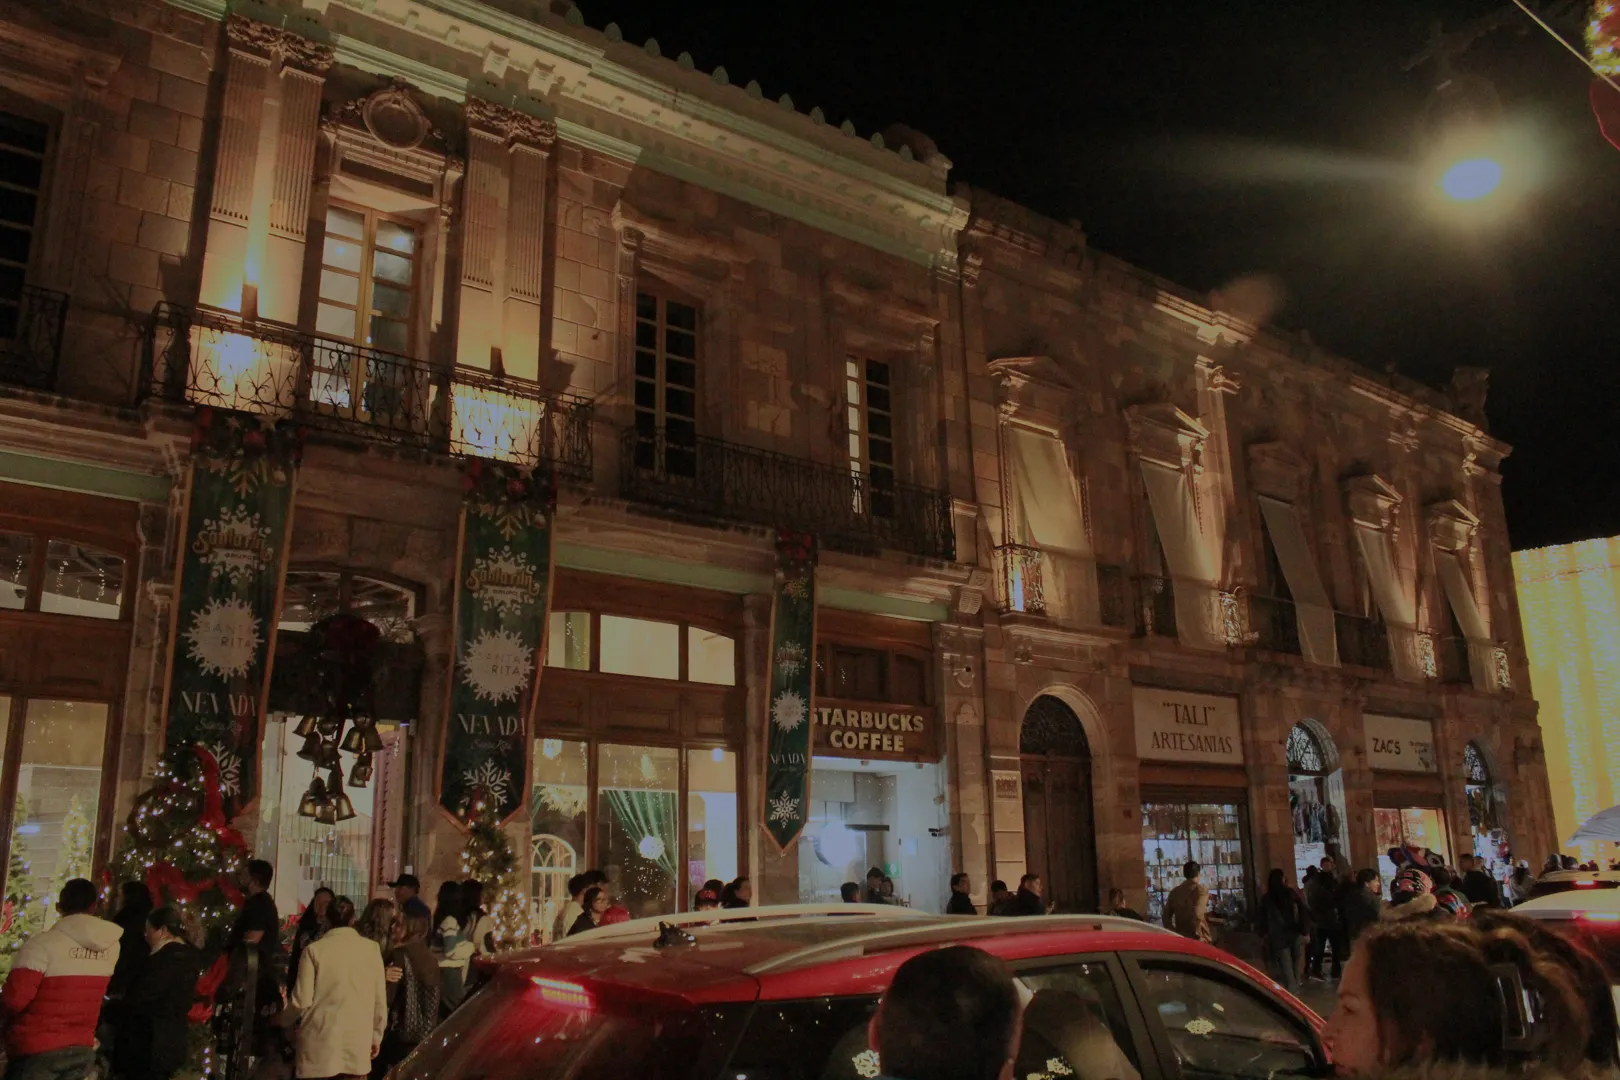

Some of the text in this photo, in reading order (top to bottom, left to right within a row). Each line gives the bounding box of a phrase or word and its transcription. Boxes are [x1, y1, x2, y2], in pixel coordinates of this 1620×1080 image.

[203, 623, 253, 637] SANTA
[220, 636, 252, 649] RITA
[491, 664, 521, 677] RITA
[830, 729, 905, 752] COFFEE
[1151, 732, 1233, 754] ARTESANIAS
